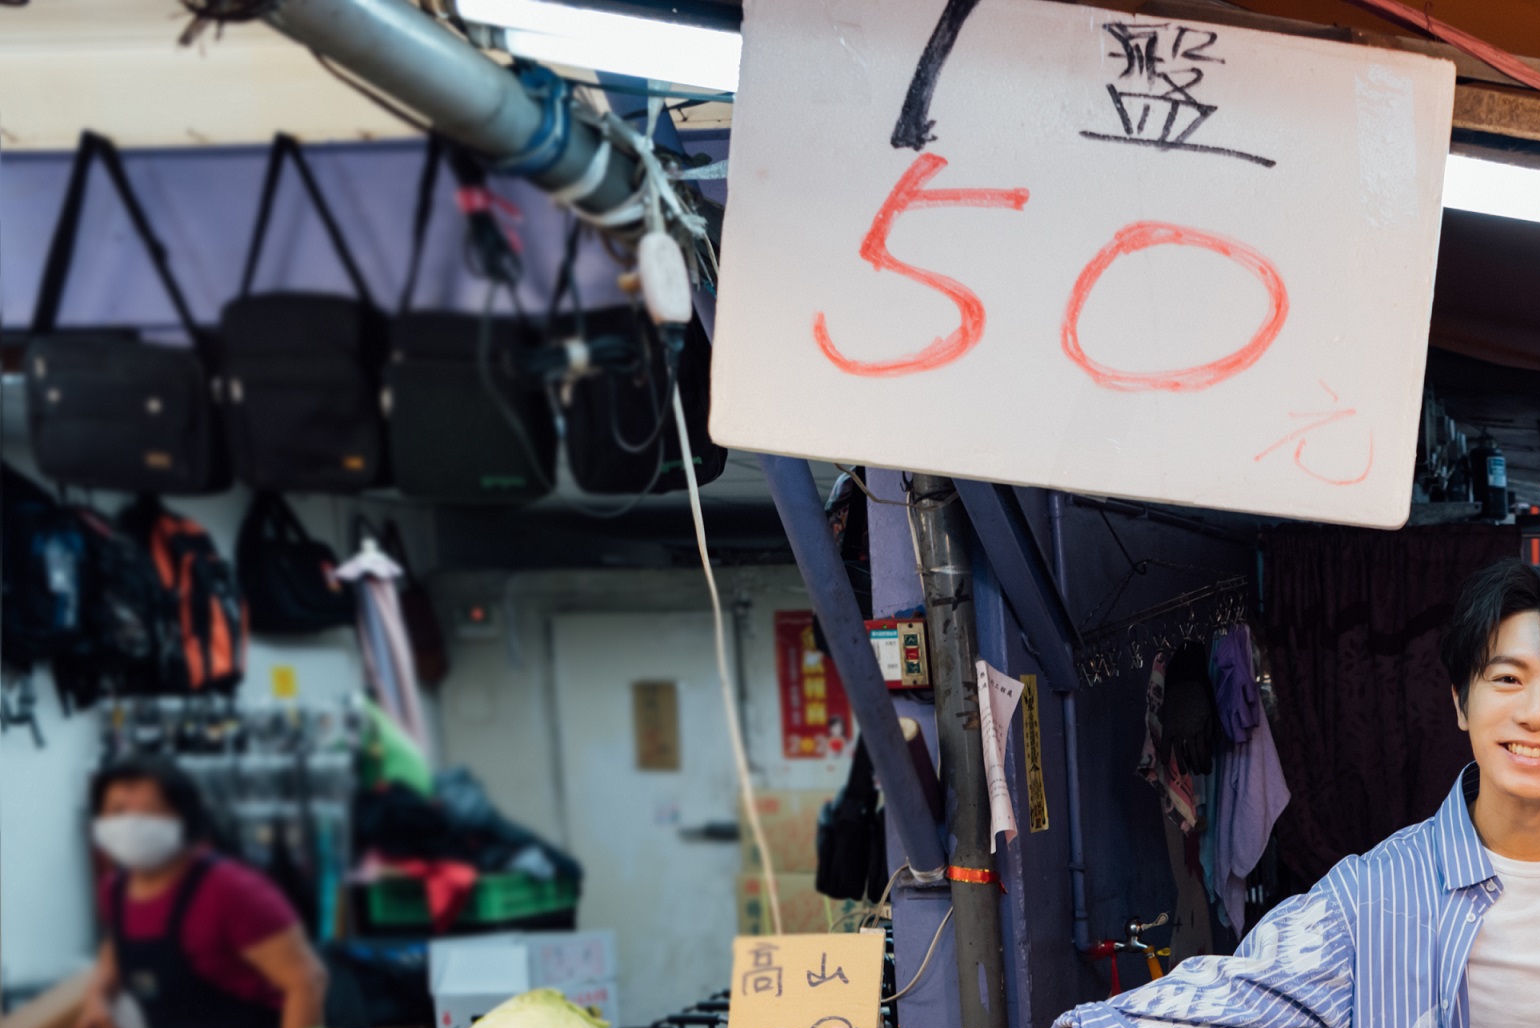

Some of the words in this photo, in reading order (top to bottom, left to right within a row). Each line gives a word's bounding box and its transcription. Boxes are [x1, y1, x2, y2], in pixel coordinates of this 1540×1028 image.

[813, 152, 1290, 392] 50
[1254, 380, 1374, 487] 元
[741, 942, 851, 998] 高山
